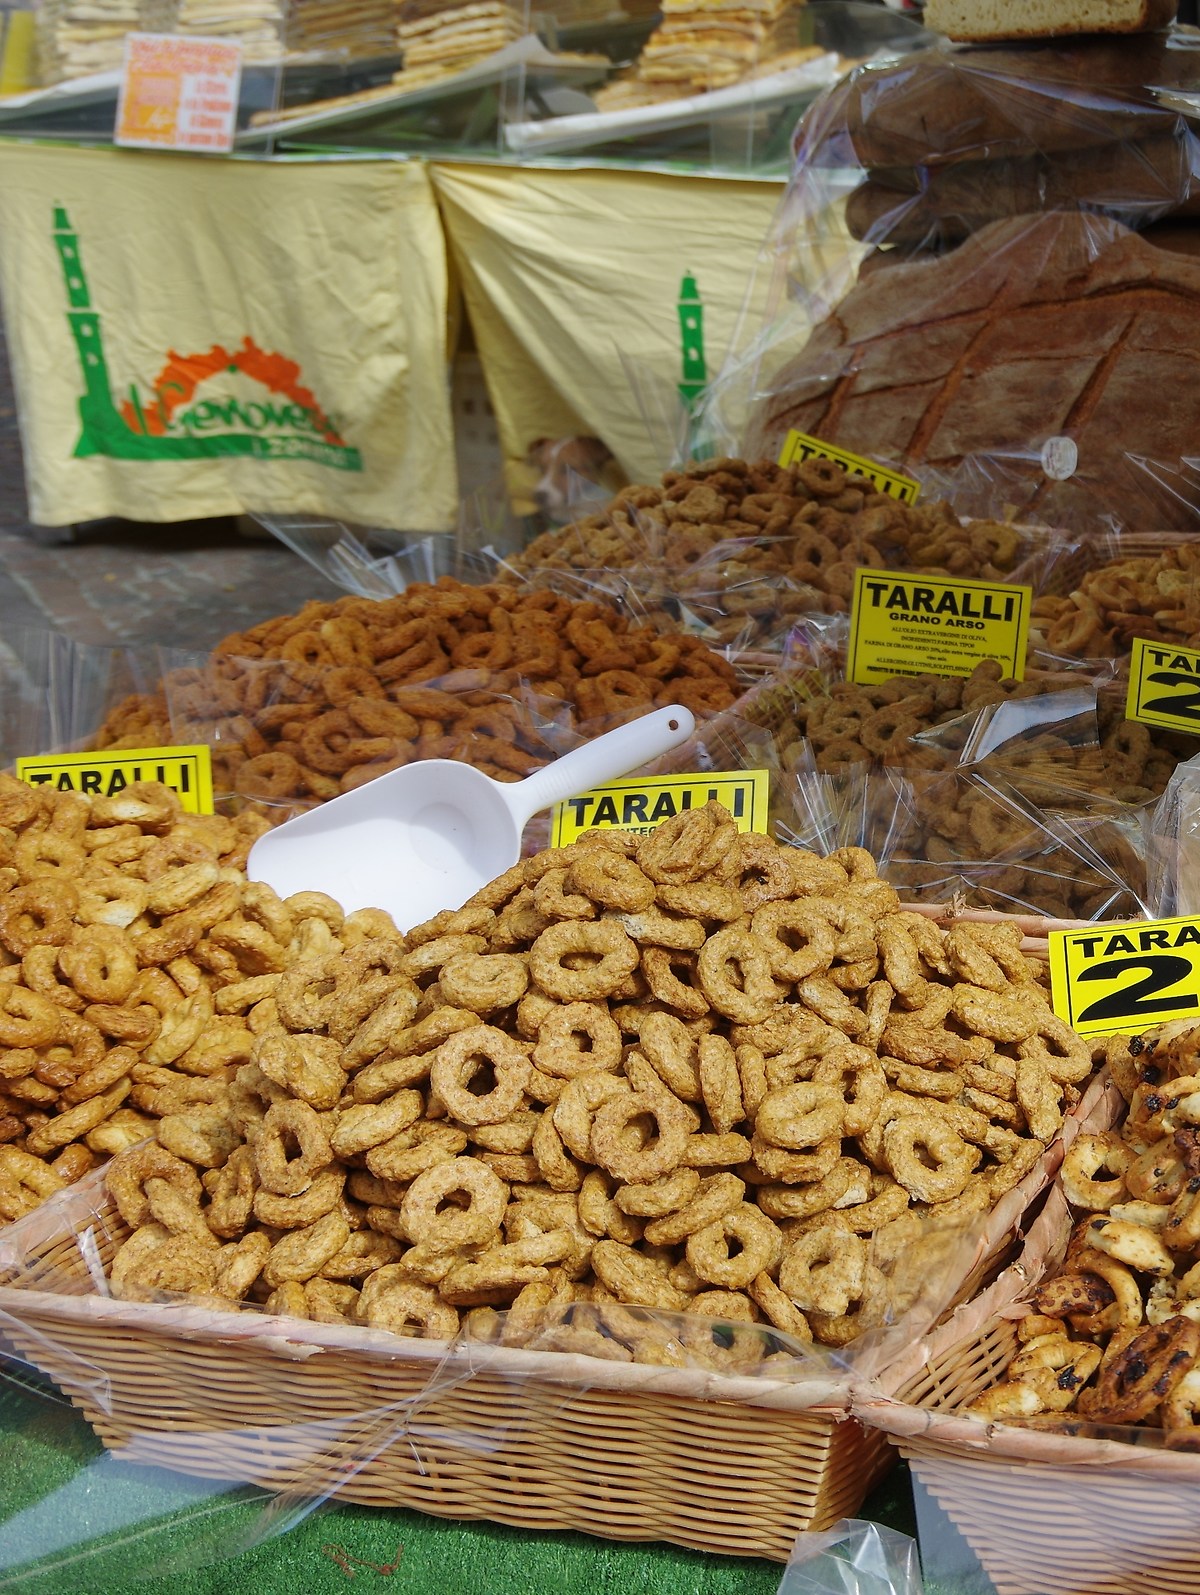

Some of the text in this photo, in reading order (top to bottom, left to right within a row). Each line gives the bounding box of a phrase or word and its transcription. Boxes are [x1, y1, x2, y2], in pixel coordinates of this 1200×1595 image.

[867, 582, 1014, 622] TARALLI
[889, 612, 985, 630] GRANO ARSO
